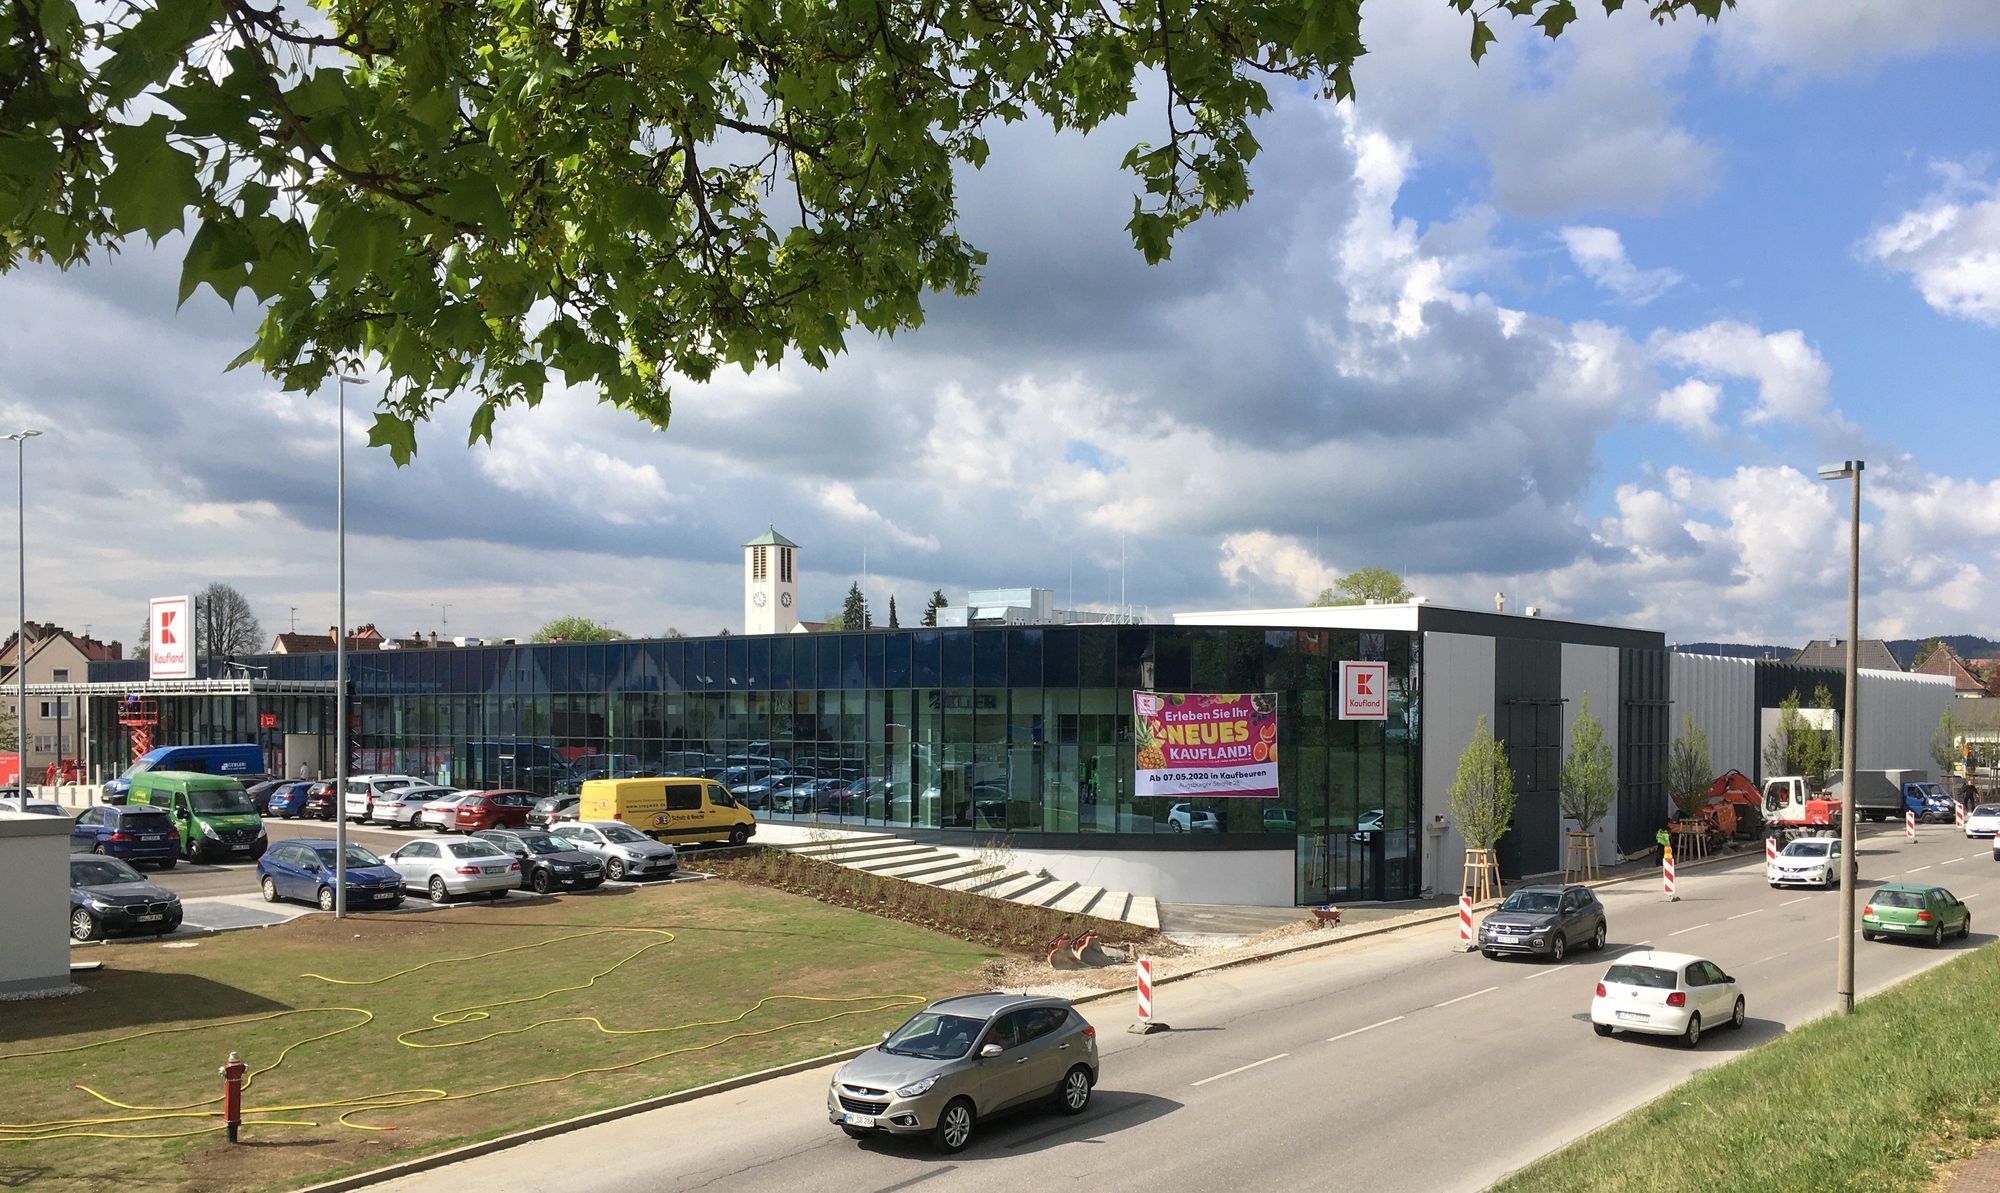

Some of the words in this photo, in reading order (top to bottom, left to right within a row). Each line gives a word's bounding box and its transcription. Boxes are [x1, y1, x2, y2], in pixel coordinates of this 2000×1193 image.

[162, 611, 176, 644] K
[154, 652, 184, 665] Kaufland
[1357, 674, 1374, 695] K
[1350, 699, 1381, 707] Kaufland
[1165, 711, 1210, 722] Erleben
[1212, 709, 1231, 719] Sie
[1232, 707, 1248, 717] Ihr
[1166, 720, 1249, 745] NEUES
[1169, 745, 1252, 760] KAUFLAND!
[1149, 773, 1161, 782] Ab
[1163, 772, 1209, 781] 07.05.2020
[1210, 772, 1218, 780] in
[1219, 770, 1267, 780] Kaufbeuren
[1178, 781, 1211, 789] Augsburger
